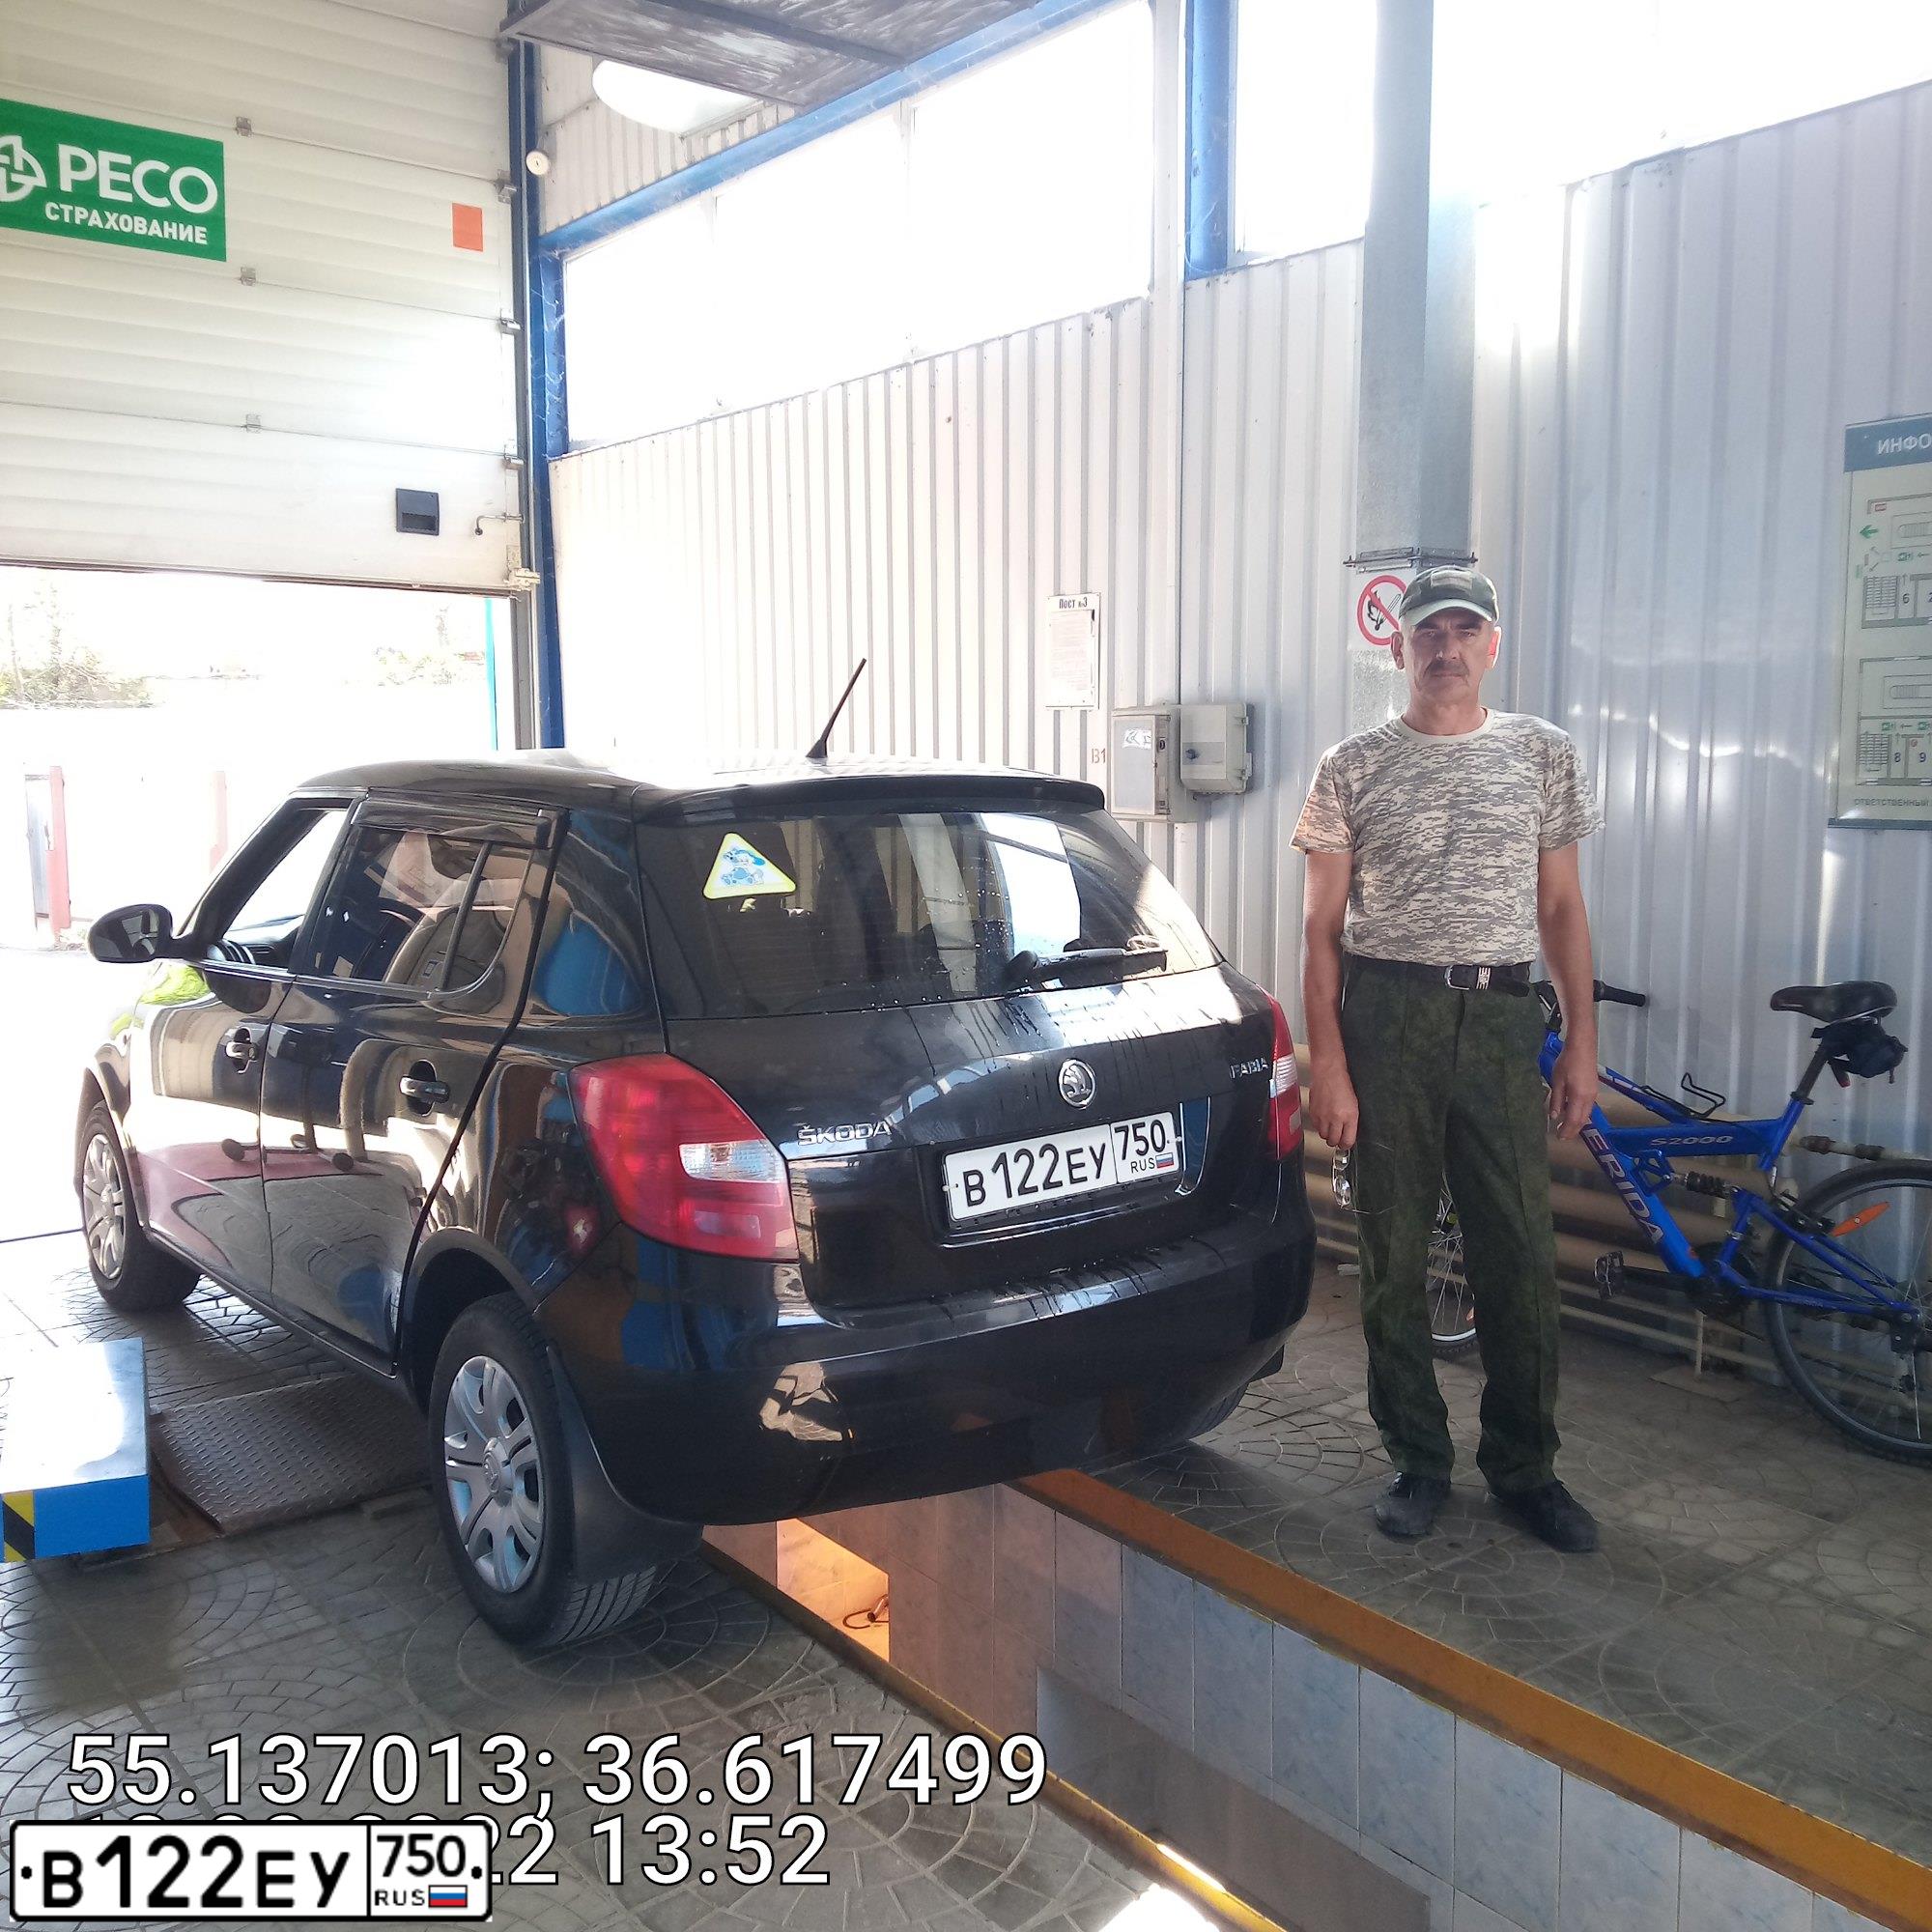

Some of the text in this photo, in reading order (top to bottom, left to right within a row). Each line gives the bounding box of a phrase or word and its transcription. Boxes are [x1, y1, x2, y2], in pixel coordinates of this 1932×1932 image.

[58, 143, 218, 213] РЕСО
[44, 202, 208, 245] СТРАХОВАНИЕ
[1902, 593, 1910, 604] 6
[1894, 753, 1927, 763] 8 9
[1230, 1057, 1268, 1079] FABIA
[1650, 1135, 1734, 1147] S2000
[963, 1119, 1166, 1208] В122ЕУ 750
[1130, 1159, 1155, 1174] RUS
[1582, 1122, 1664, 1244] ERIDA
